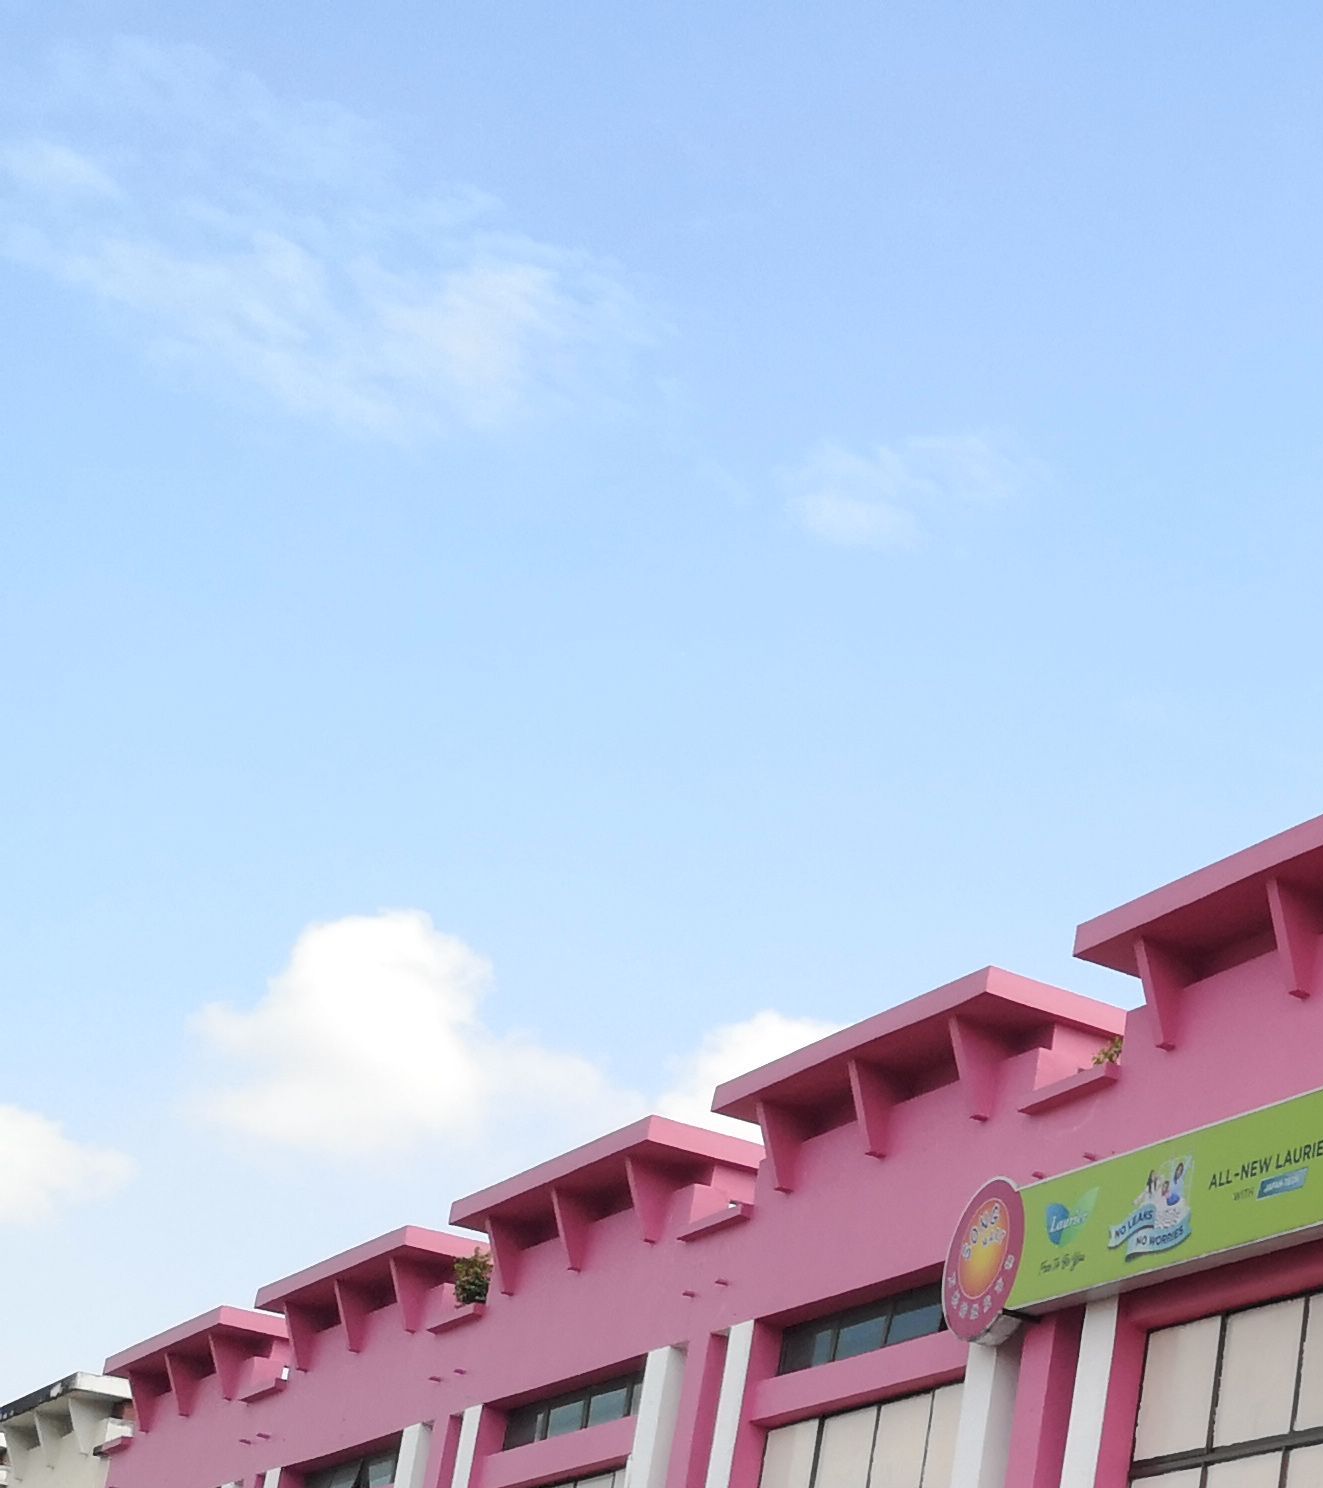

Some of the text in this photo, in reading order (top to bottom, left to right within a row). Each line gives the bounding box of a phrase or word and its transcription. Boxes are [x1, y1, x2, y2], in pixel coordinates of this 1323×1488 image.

[1208, 1155, 1273, 1191] ALL-NEW
[1114, 1209, 1154, 1239] NO LEAKS
[1135, 1225, 1185, 1246] NO WORRIES
